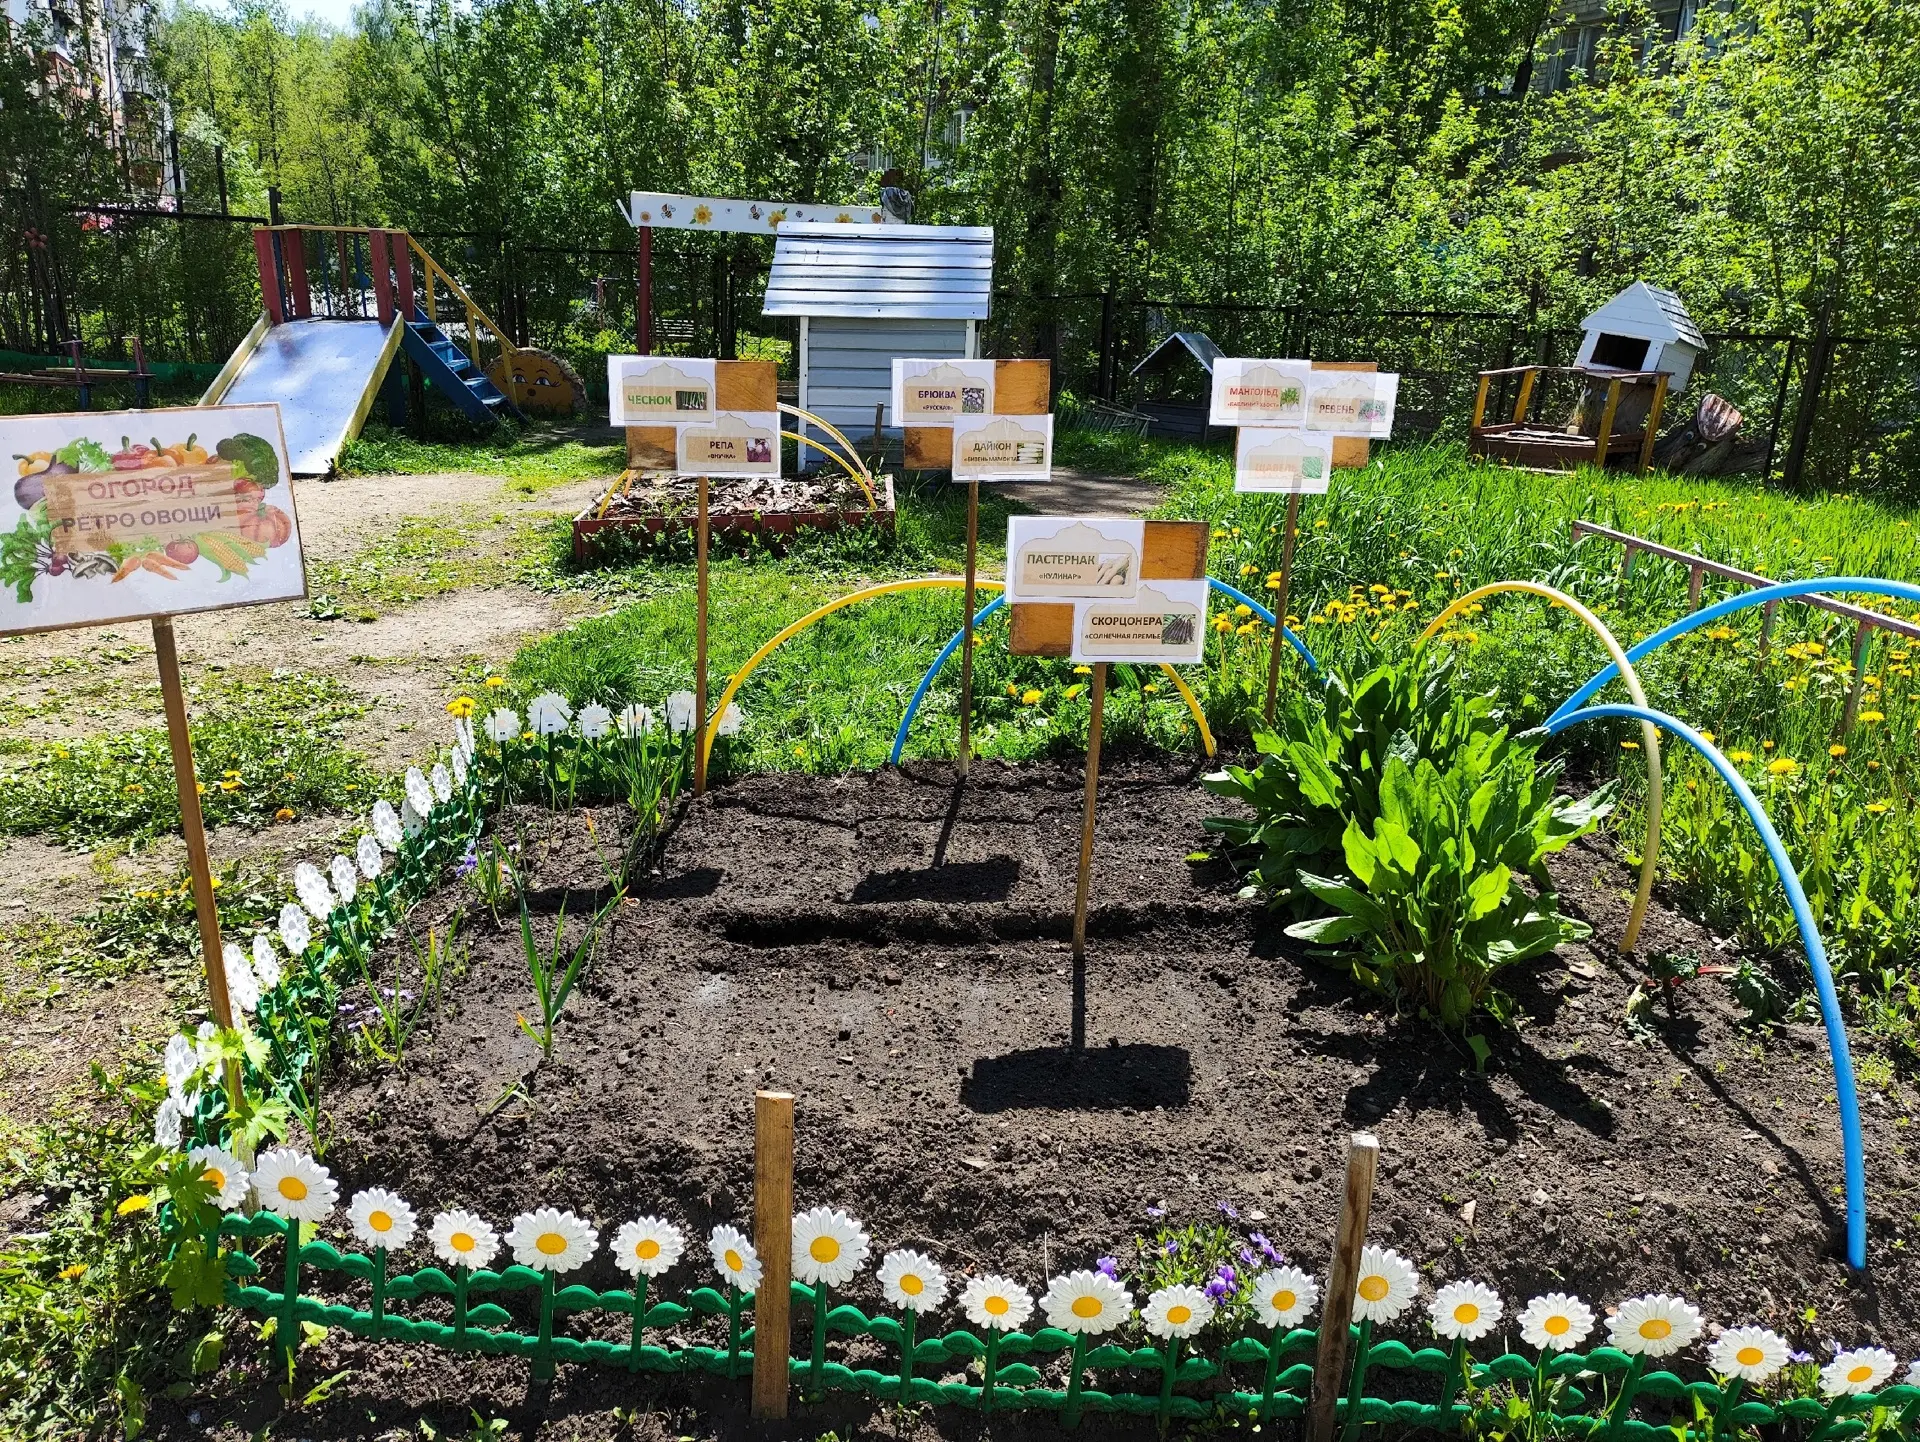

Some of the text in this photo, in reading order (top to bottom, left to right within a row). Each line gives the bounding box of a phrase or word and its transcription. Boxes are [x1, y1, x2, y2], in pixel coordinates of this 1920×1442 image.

[918, 390, 957, 399] БРЮКВА
[1229, 387, 1279, 398] МАНГОЛЬД
[628, 395, 672, 405] ЧЕСНОК
[1318, 404, 1355, 414] РЕВЕНЬ
[709, 441, 734, 450] РЕПА
[973, 440, 1012, 453] ДАЙКОН
[1255, 463, 1297, 473] ЩАВЕЛЬ
[87, 475, 196, 499] ОГОРОД
[61, 504, 221, 534] РЕТРО ОВОЩИ
[1027, 554, 1096, 566] ПАСТЕРНАК
[1038, 572, 1082, 581] «КУЛИНАР»
[1091, 616, 1163, 628] СКОРЦОНЕРА
[1084, 632, 1131, 640] «СОЛНЕЧНАЯ
